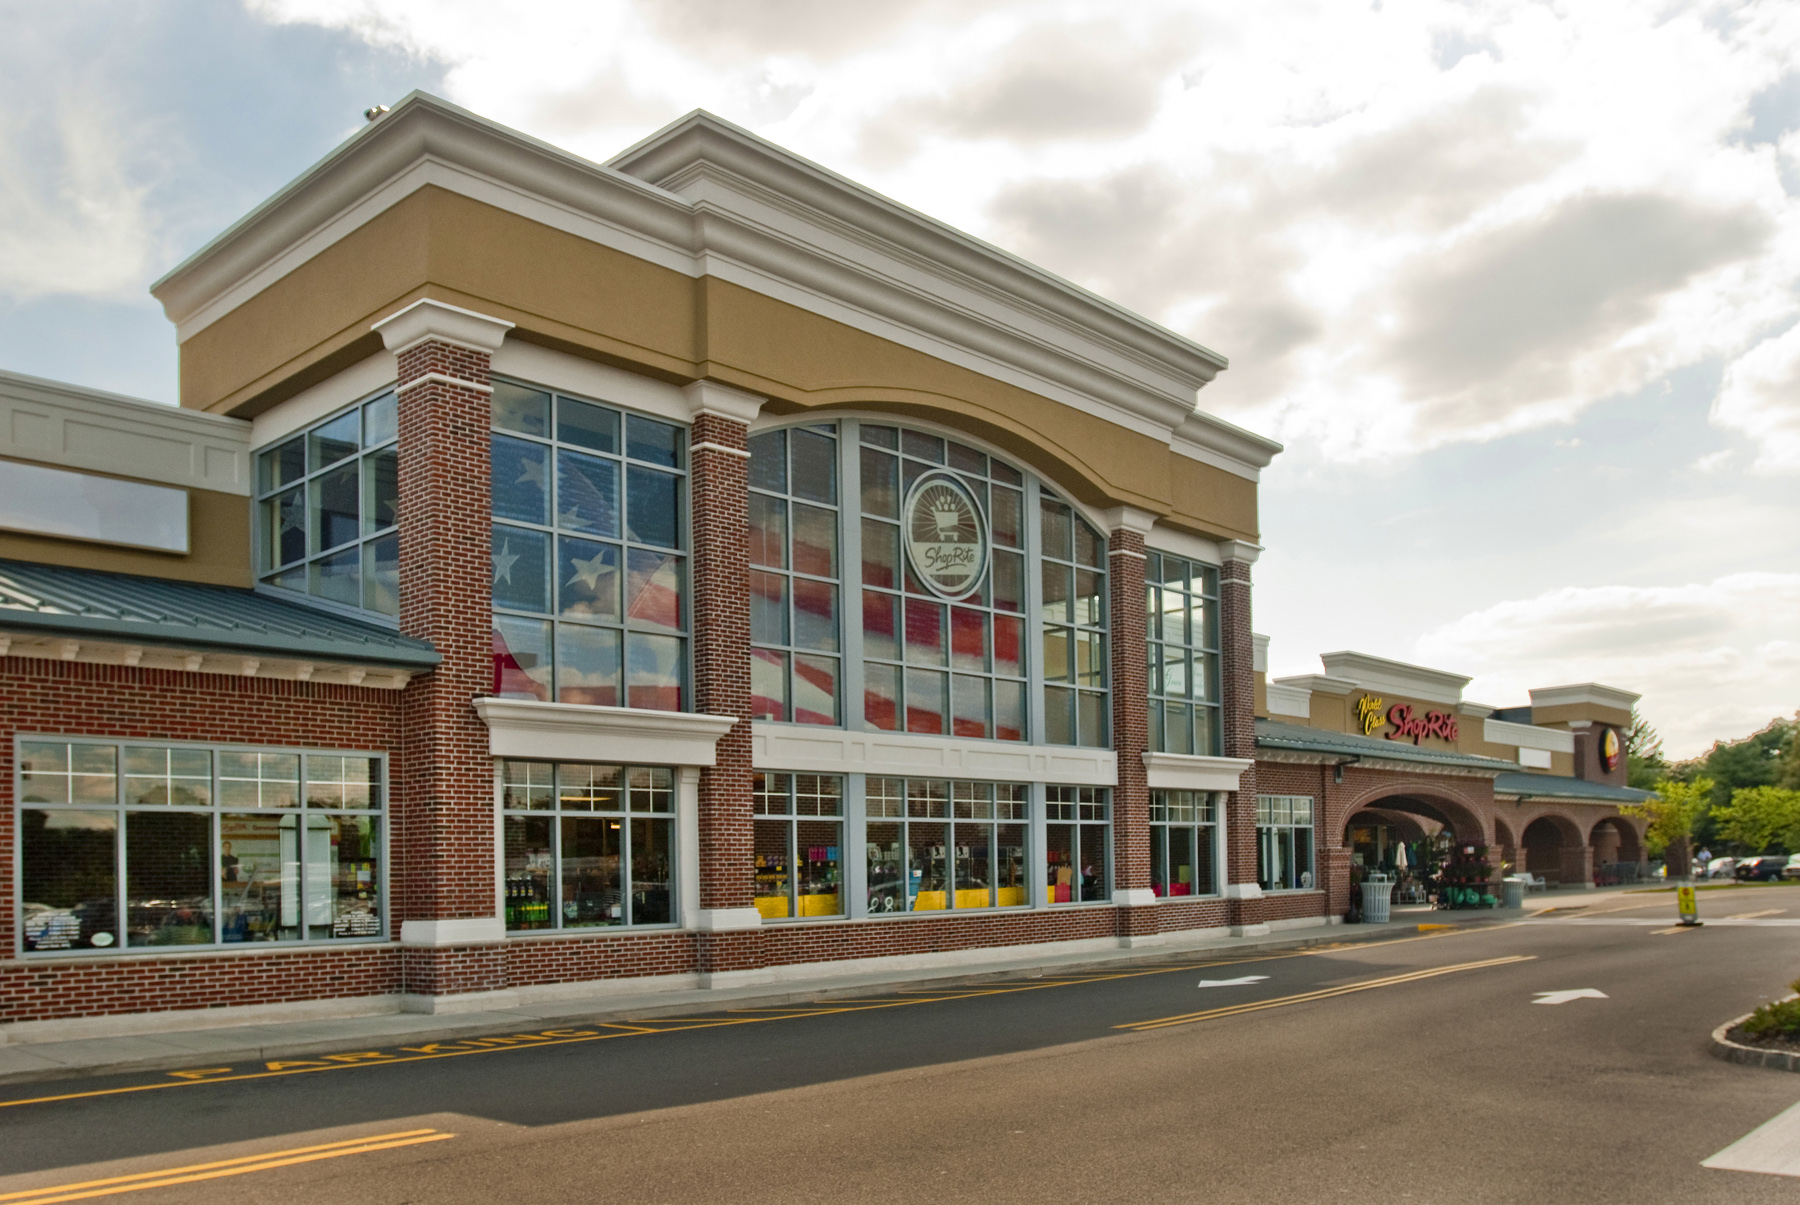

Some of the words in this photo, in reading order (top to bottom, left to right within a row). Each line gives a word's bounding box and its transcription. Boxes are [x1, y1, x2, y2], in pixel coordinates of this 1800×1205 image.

[924, 545, 975, 569] ShopRite
[1358, 693, 1383, 721] World
[1364, 711, 1387, 736] Class
[1386, 703, 1459, 746] ShopRite
[166, 1028, 600, 1080] PARKING
